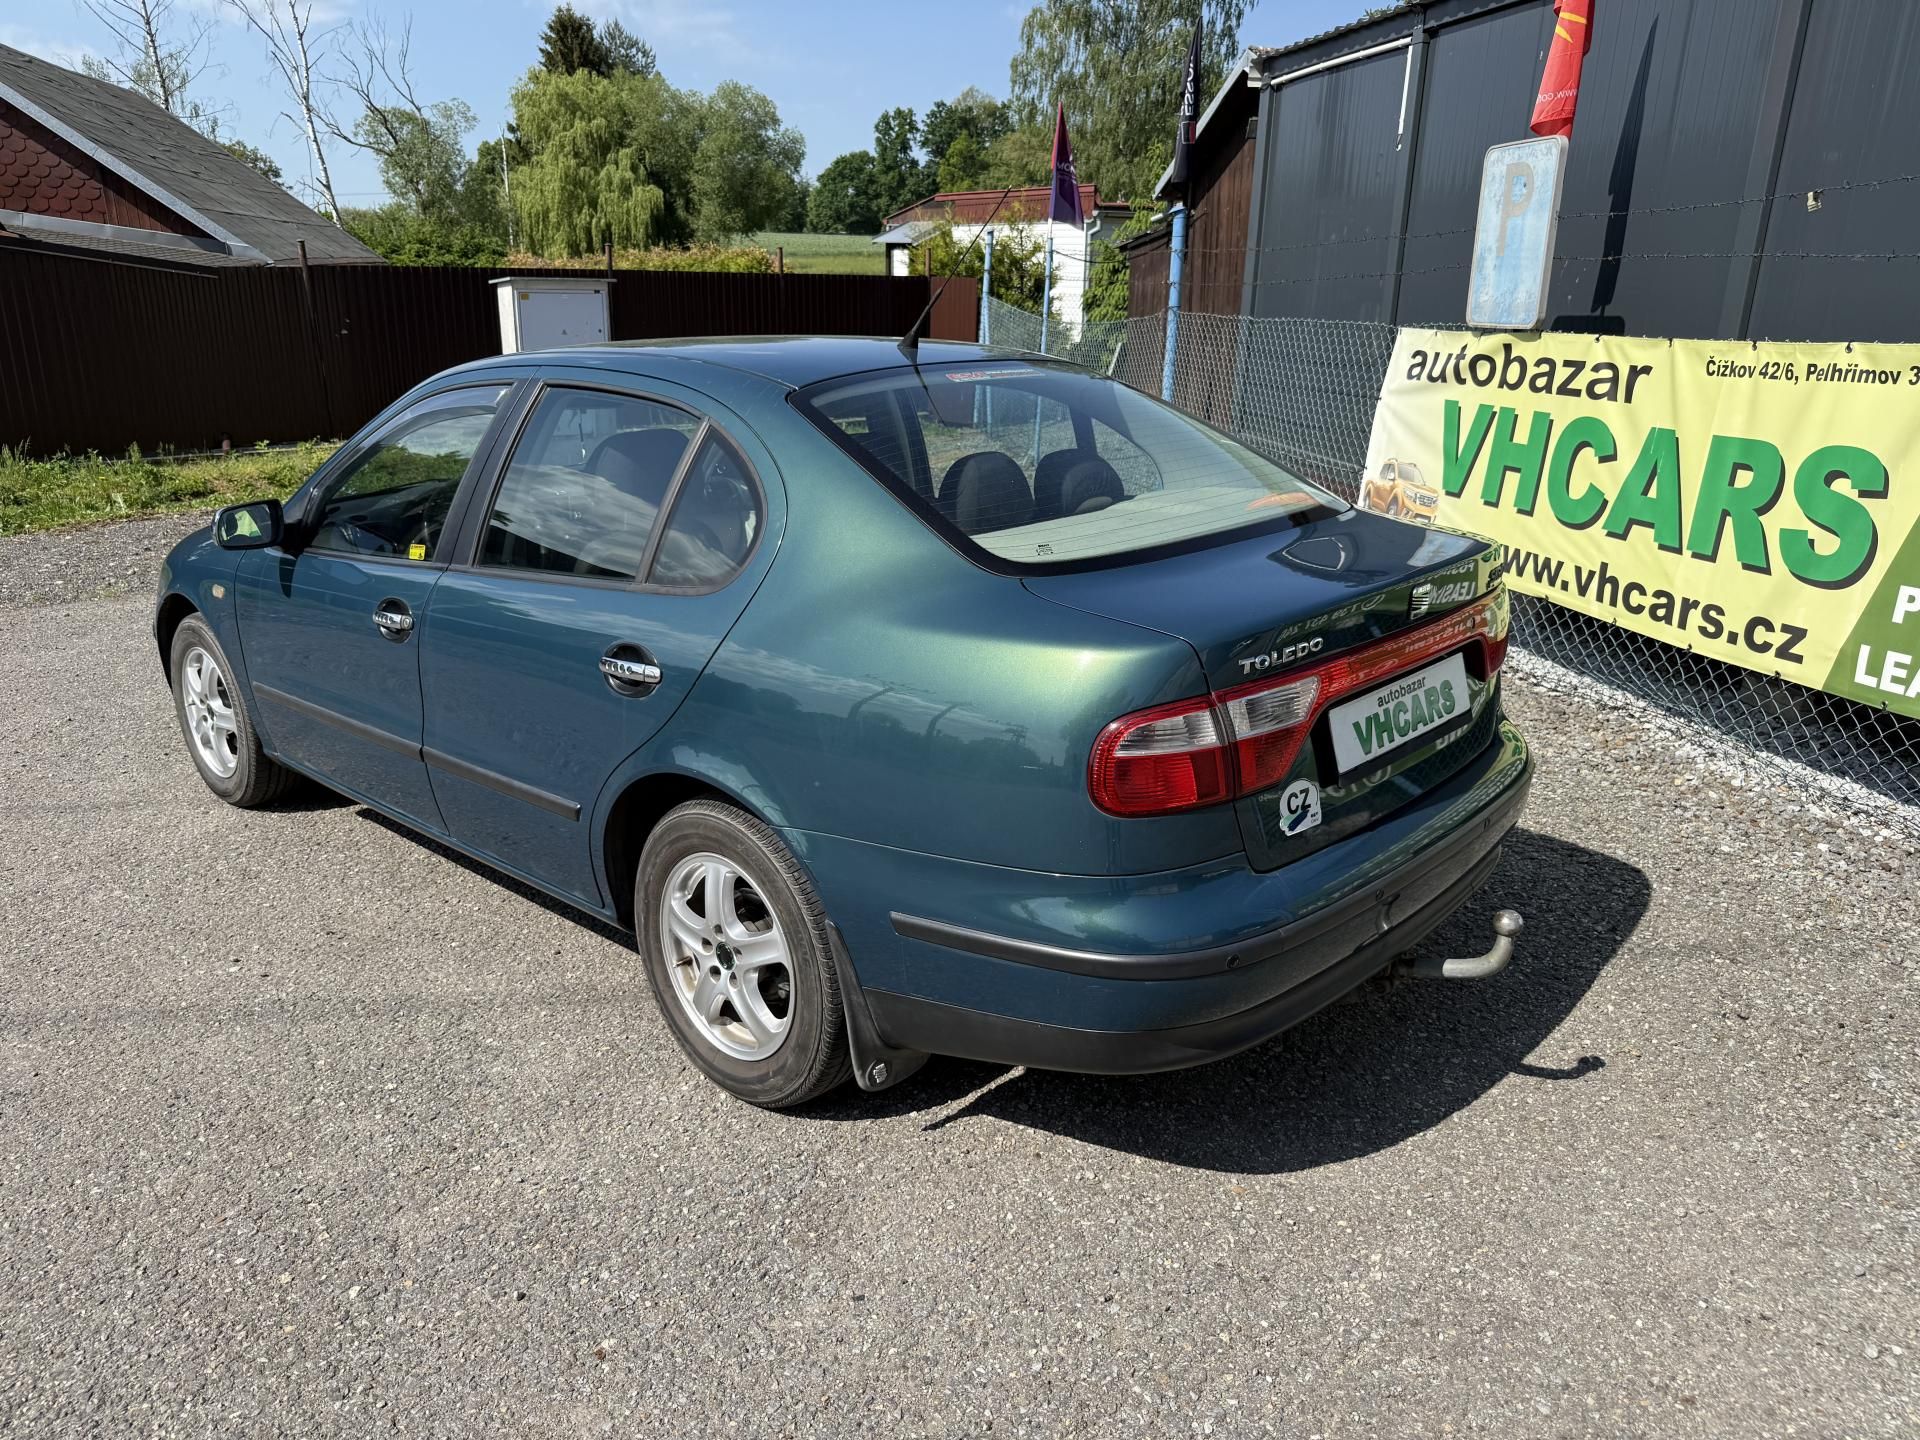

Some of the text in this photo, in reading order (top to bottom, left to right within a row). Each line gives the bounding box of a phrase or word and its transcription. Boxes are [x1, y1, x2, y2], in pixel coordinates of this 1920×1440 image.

[1496, 161, 1534, 257] P
[1406, 344, 1654, 404] autobazar
[1706, 356, 1757, 379] Čížkov
[1759, 361, 1799, 385] 42/6,
[1805, 363, 1902, 385] Pelhřimov
[1442, 399, 1889, 590] VHCARS
[1500, 544, 1809, 665] ww.vhcars.cz
[1238, 637, 1324, 674] TOLEDO
[1352, 679, 1456, 756] VHCARS
[1377, 675, 1426, 707] autobazar
[1286, 787, 1312, 815] CZ
